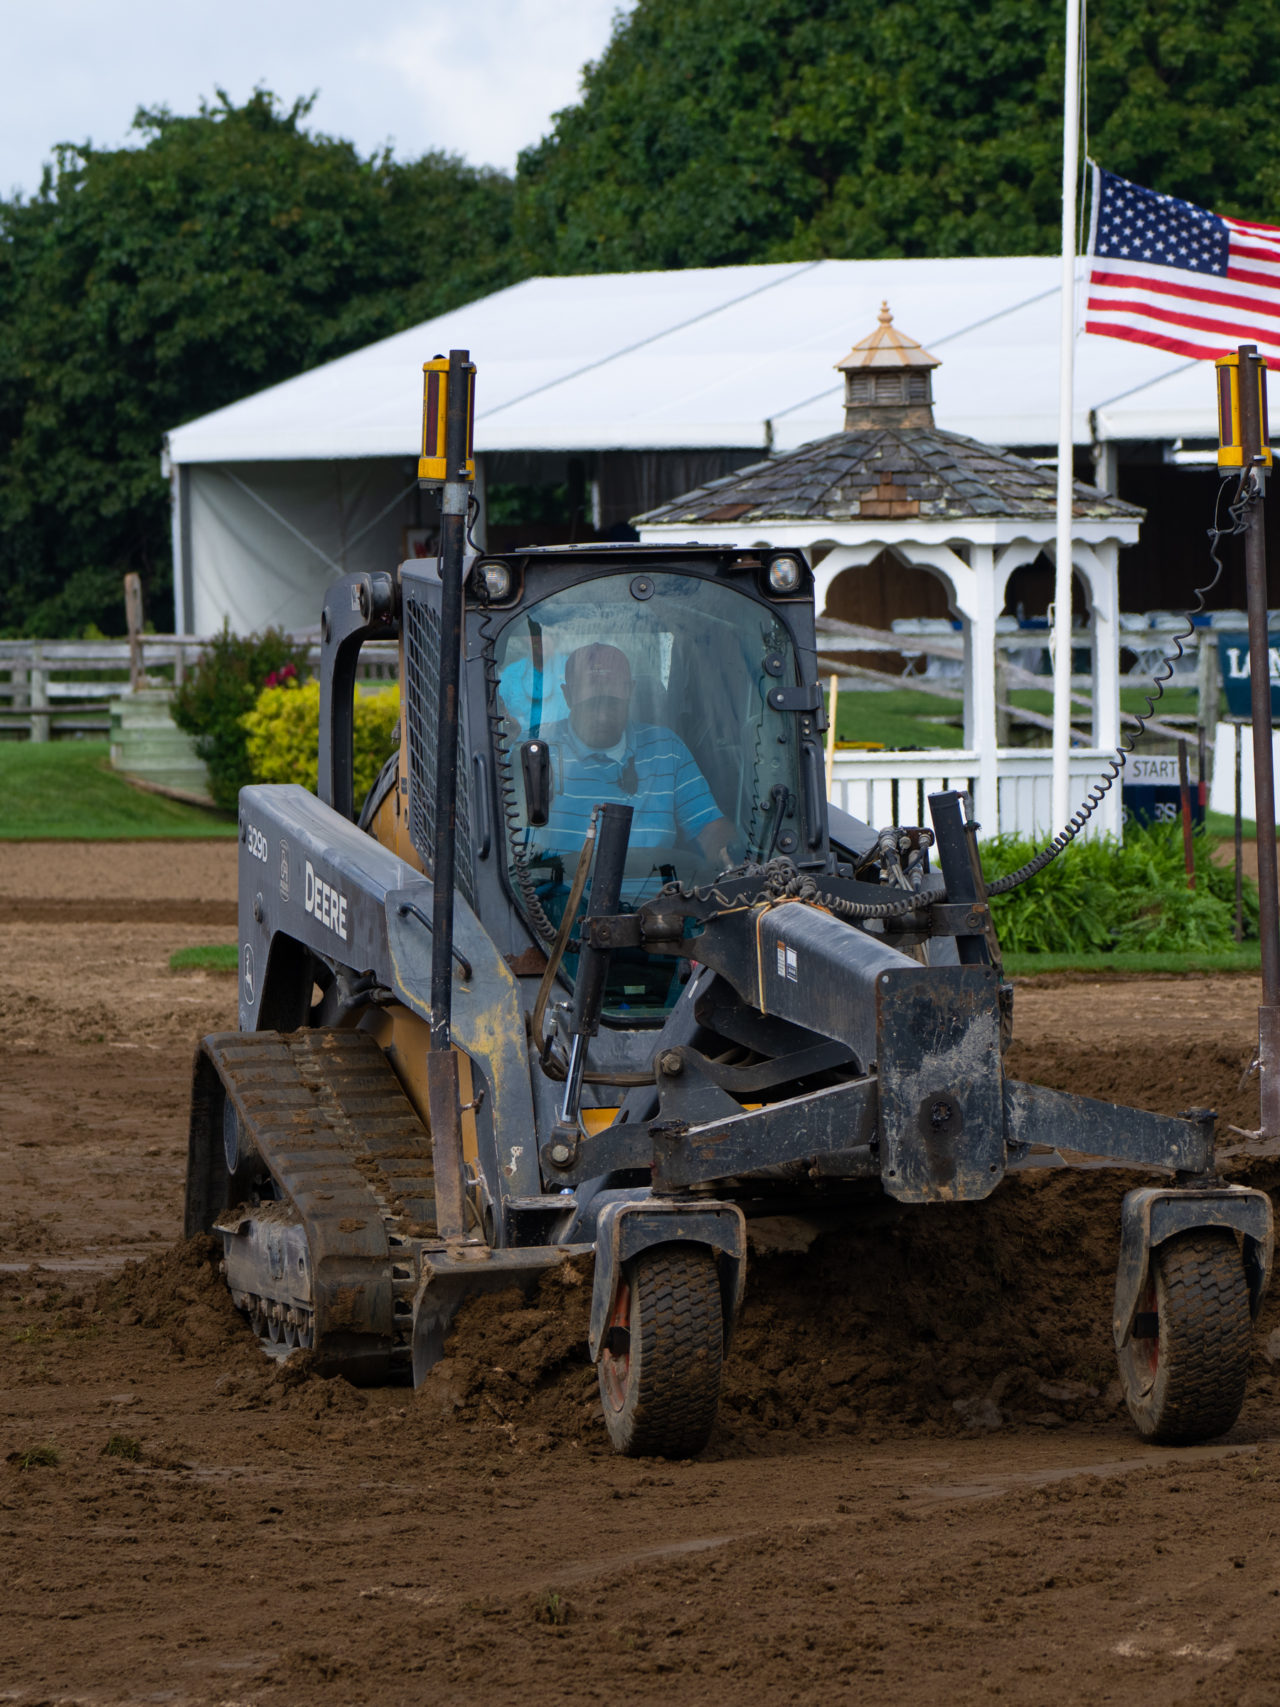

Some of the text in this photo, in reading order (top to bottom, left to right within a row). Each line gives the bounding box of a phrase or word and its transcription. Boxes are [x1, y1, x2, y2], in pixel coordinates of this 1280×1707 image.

[1132, 760, 1177, 778] START
[247, 824, 268, 863] 329D
[305, 860, 348, 941] DEERE
